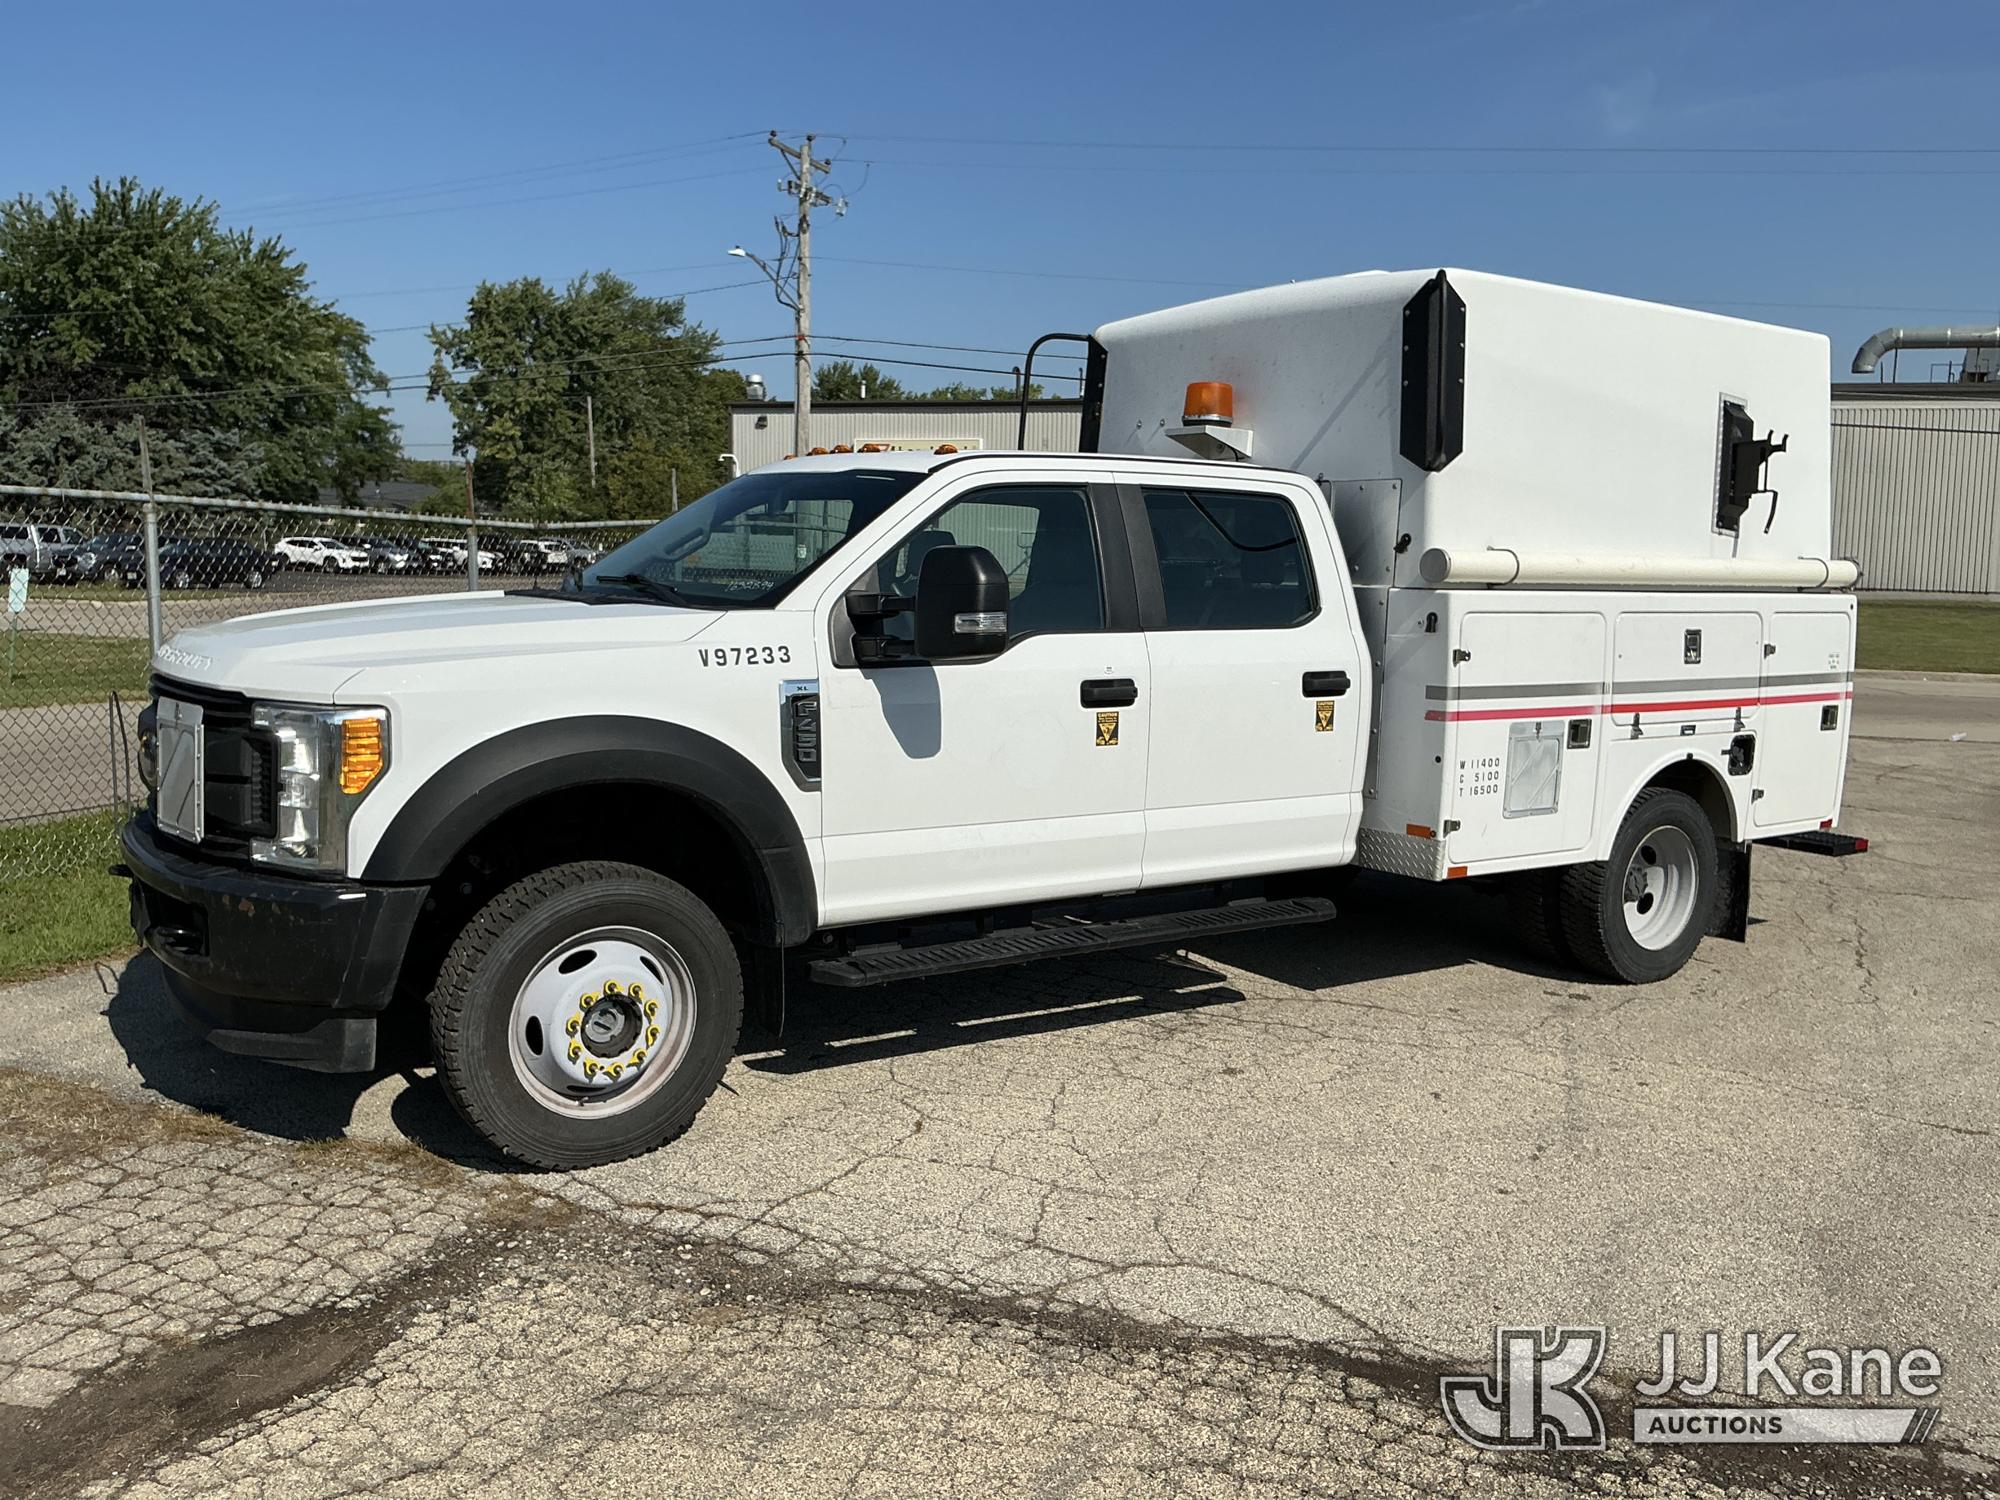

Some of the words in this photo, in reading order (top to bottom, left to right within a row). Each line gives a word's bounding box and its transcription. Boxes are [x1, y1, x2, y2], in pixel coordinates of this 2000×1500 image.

[698, 645, 791, 667] V97233
[1460, 760, 1466, 769] W
[1471, 758, 1499, 768] 11400
[1475, 771, 1498, 782] 5100
[1459, 788, 1463, 797] T
[1470, 784, 1498, 796] 16500
